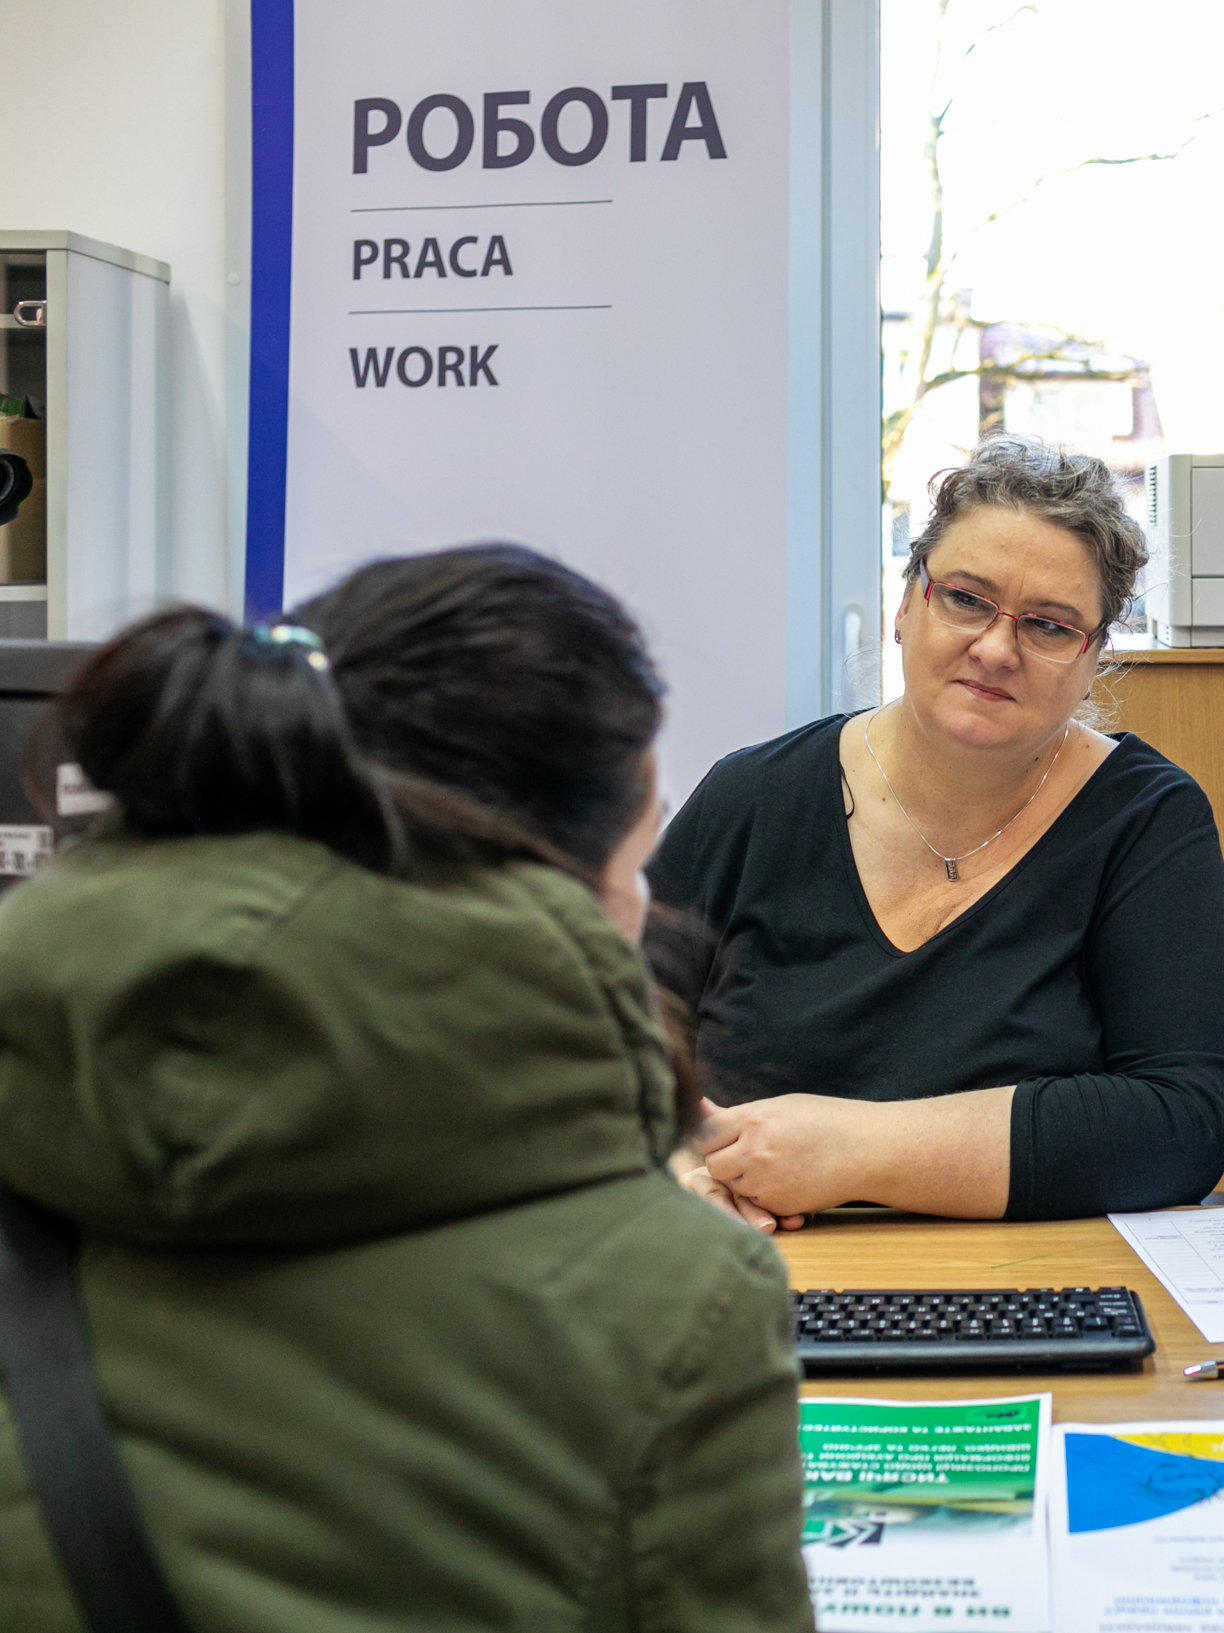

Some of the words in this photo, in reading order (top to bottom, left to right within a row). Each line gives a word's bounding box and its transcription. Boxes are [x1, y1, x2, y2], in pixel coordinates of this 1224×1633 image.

[352, 81, 728, 175] РОБОТА
[352, 234, 514, 281] PRACA
[348, 344, 500, 389] WORK
